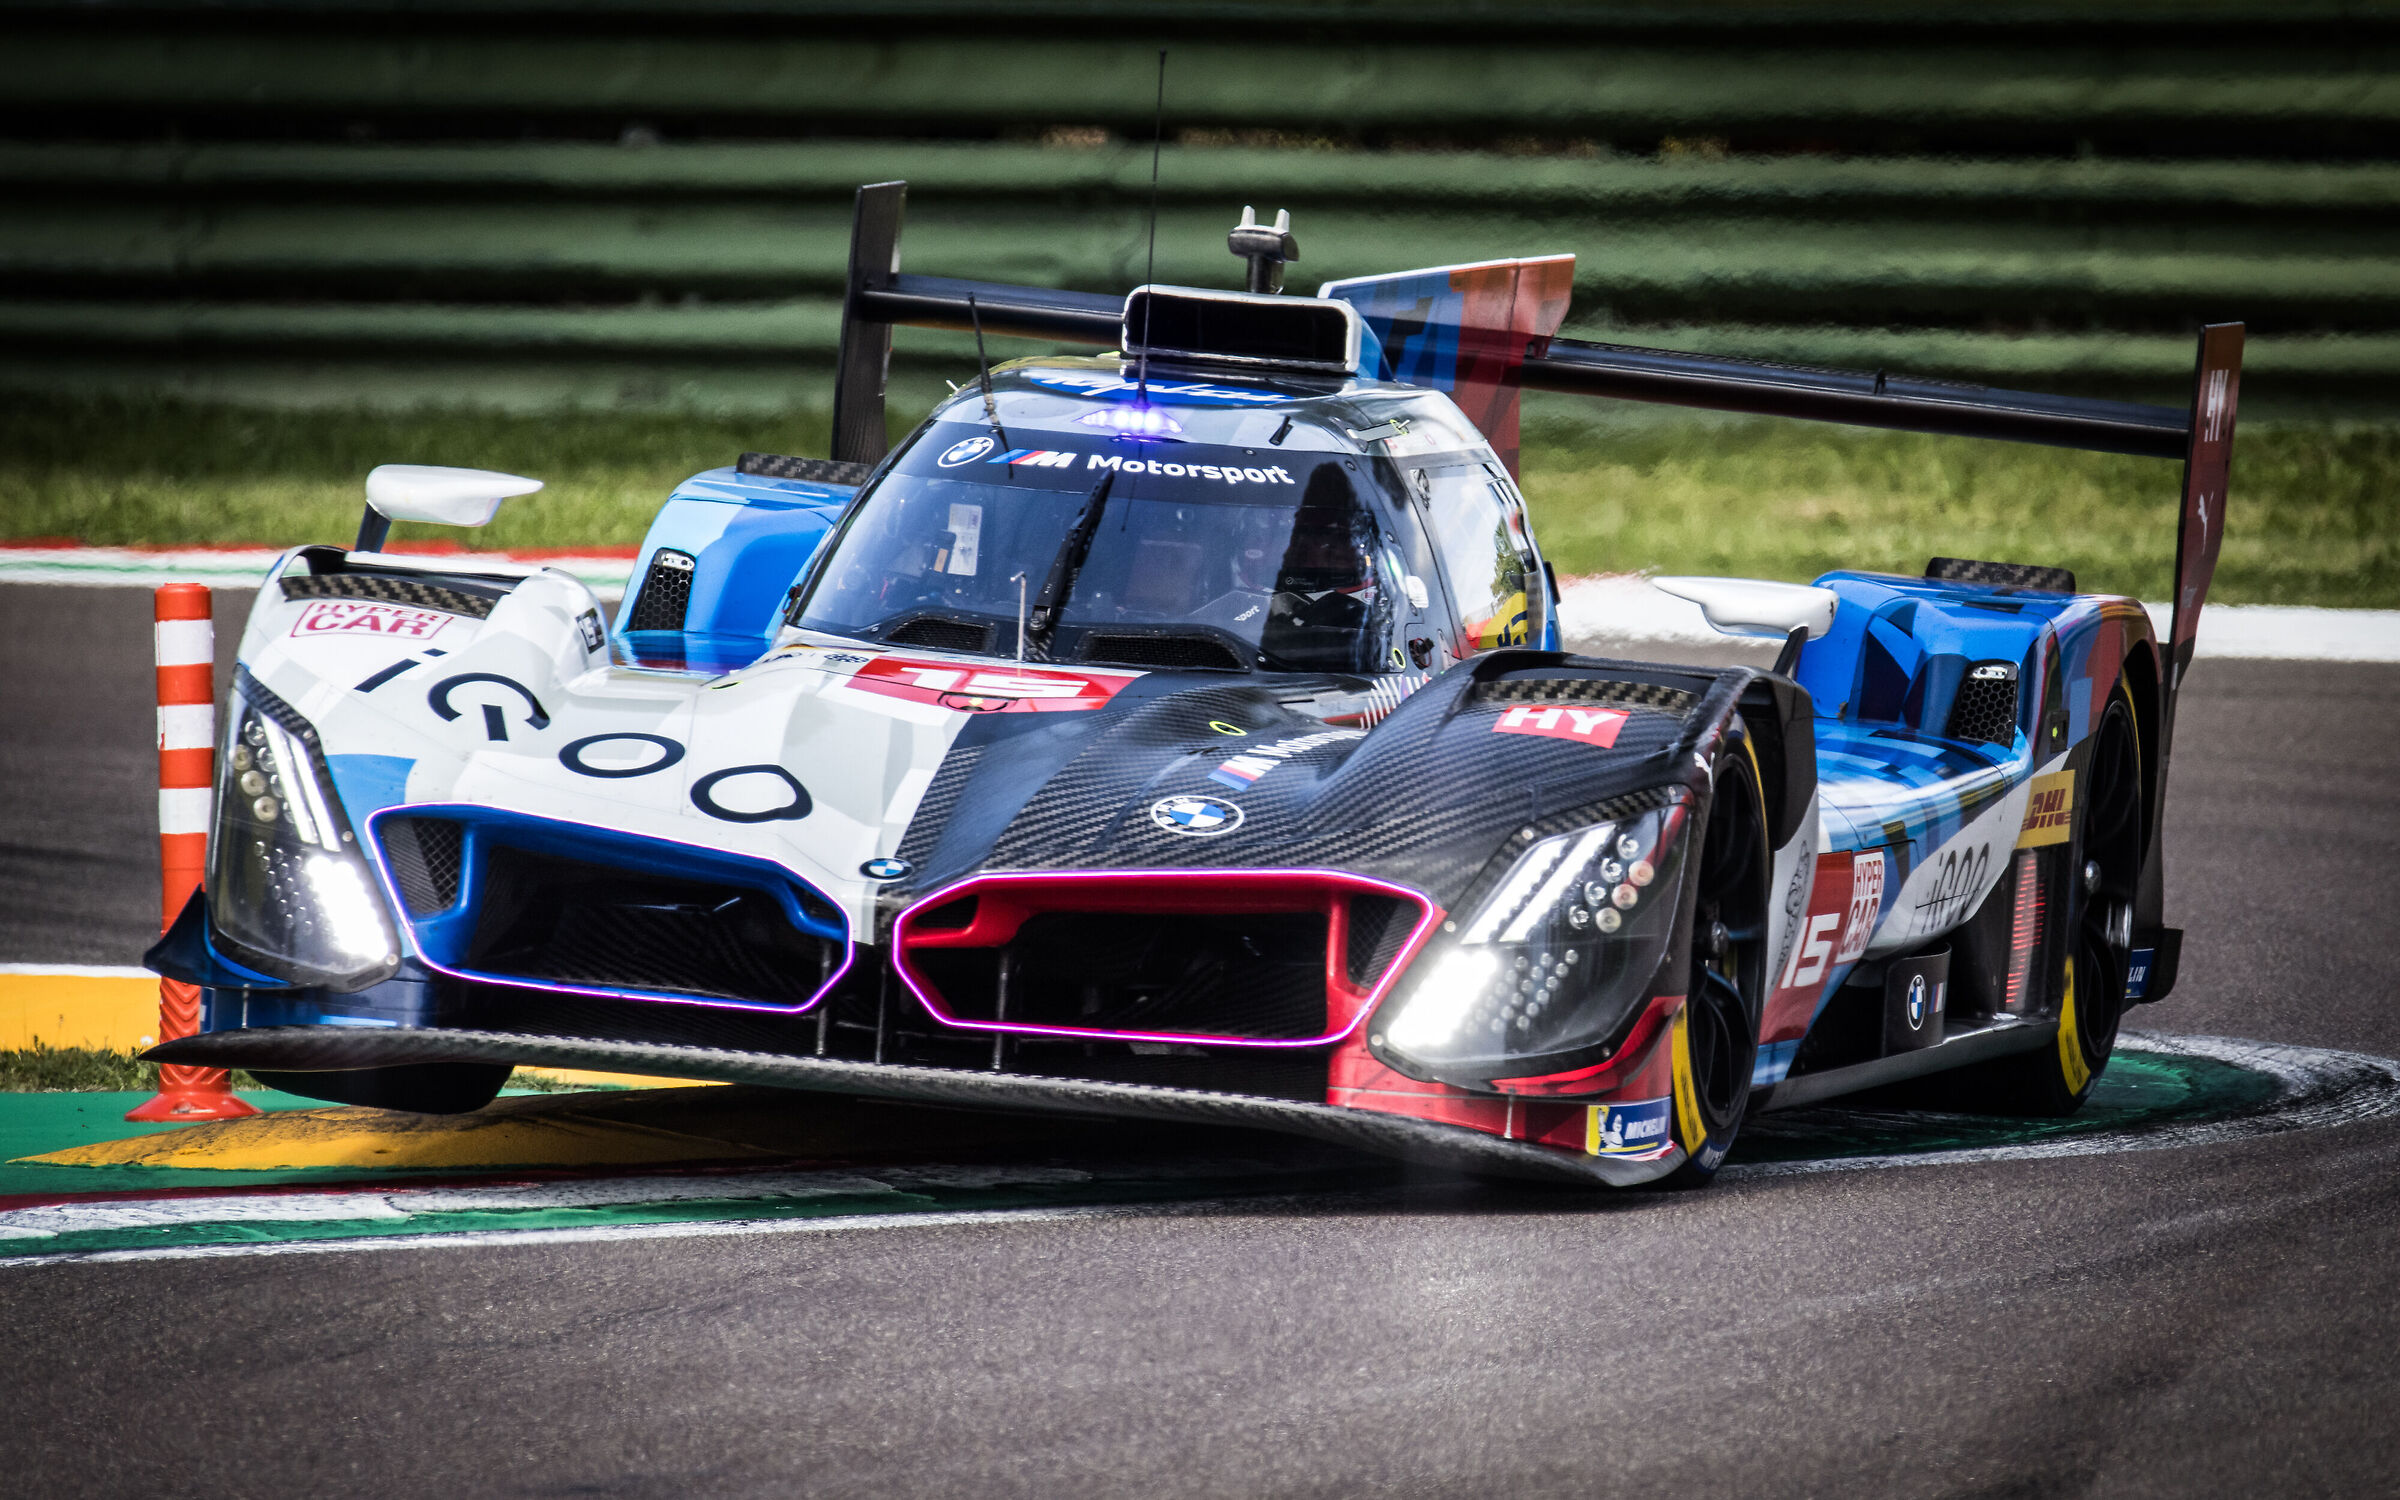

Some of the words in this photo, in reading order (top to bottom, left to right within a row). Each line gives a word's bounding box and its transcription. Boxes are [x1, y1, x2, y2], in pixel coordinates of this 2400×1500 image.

[1087, 454, 1295, 485] Motorsport
[306, 613, 430, 635] CAR
[317, 603, 439, 621] HYPER
[901, 667, 1088, 697] 15
[1502, 707, 1622, 735] HY
[2027, 788, 2069, 830] DHL
[1854, 860, 1884, 898] HYPER
[1839, 898, 1879, 956] CAR
[1781, 912, 1841, 989] 15
